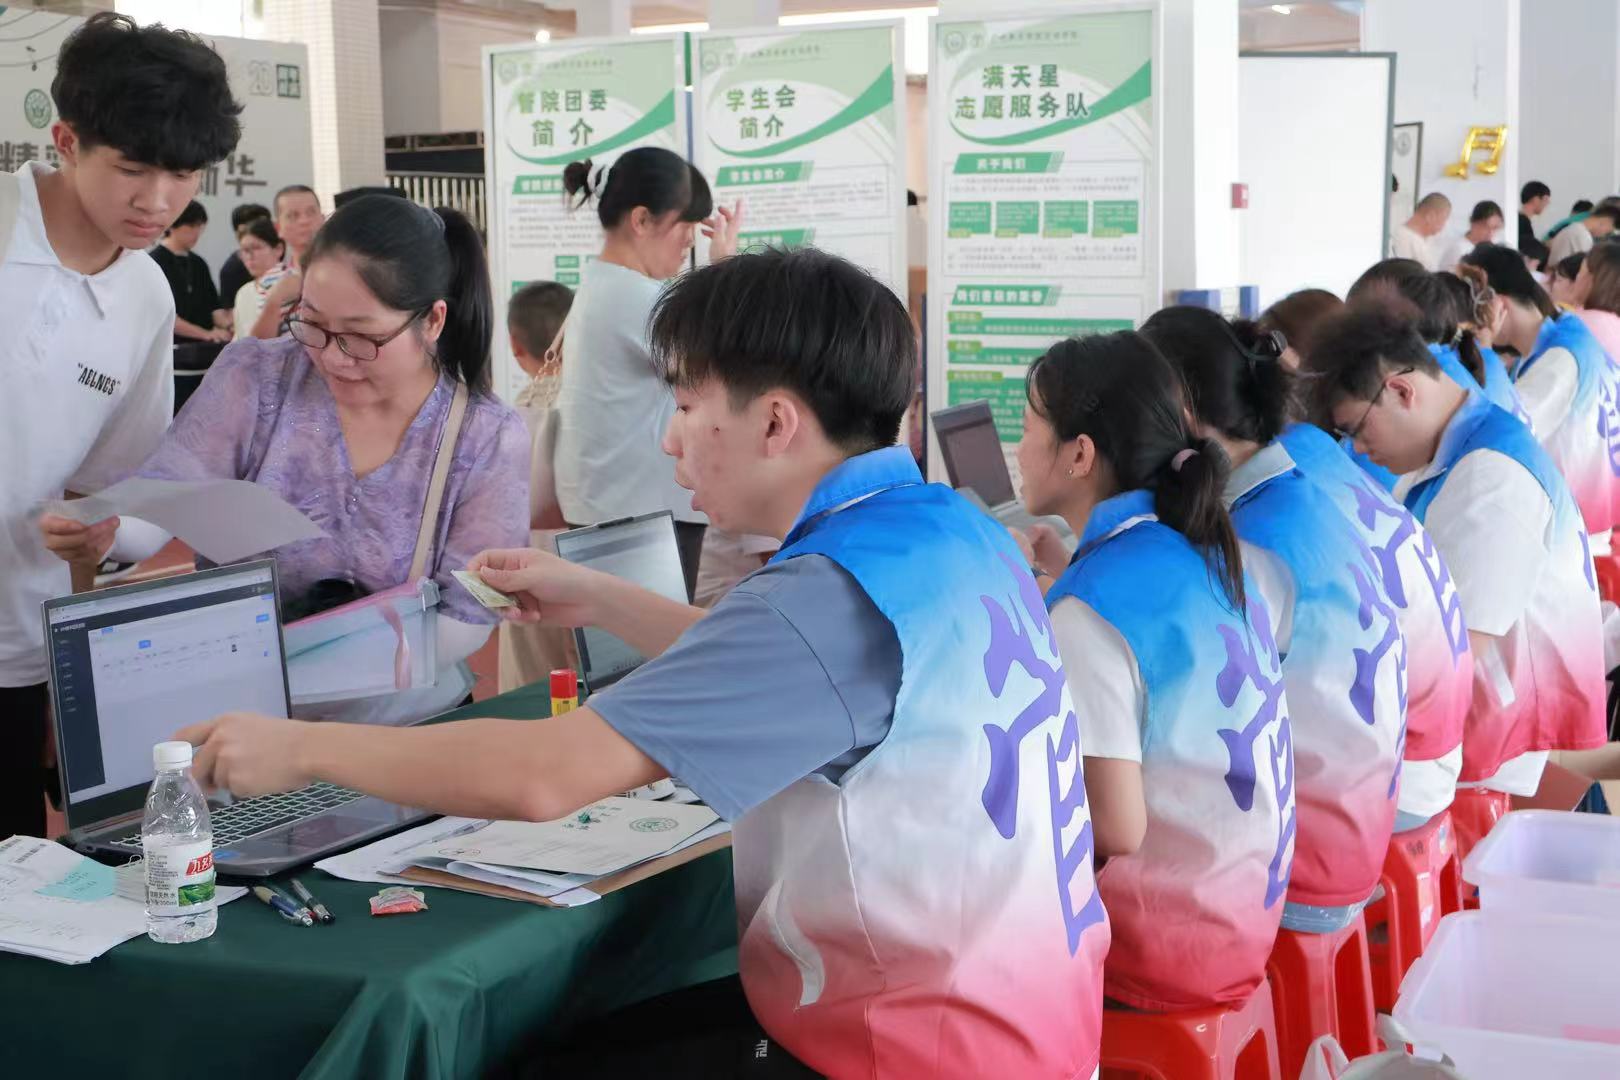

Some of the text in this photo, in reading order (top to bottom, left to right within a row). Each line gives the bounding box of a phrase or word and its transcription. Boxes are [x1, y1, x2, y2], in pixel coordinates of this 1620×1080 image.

[982, 63, 1060, 89] 满天星
[726, 84, 796, 112] 学生会
[955, 92, 1089, 120] 志愿服务队
[531, 117, 594, 147] 简介
[739, 113, 785, 140] 简介
